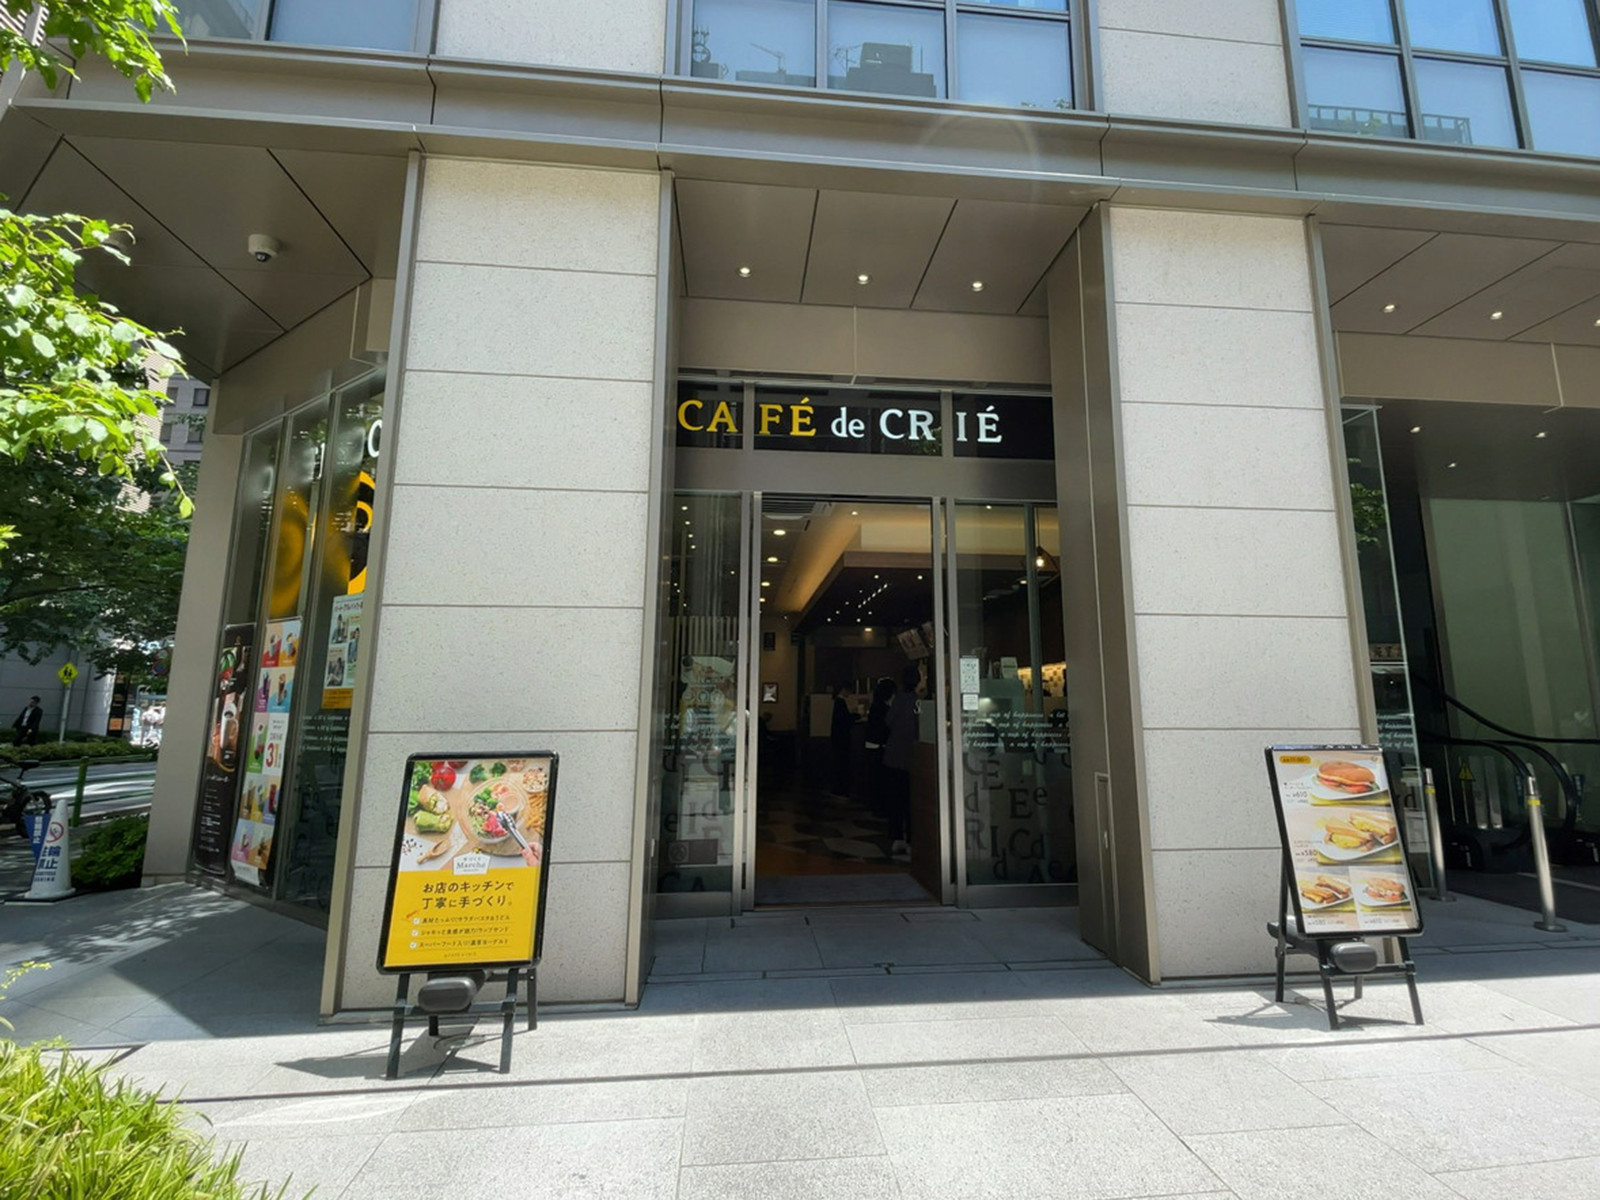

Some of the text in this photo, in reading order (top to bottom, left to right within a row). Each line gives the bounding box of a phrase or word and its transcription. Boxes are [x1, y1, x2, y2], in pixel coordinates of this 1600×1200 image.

[677, 397, 1003, 444] CAFÉ de CRIÉ
[422, 880, 514, 894] お店のキッチンで
[422, 895, 513, 910] 丁寧に手づくり。
